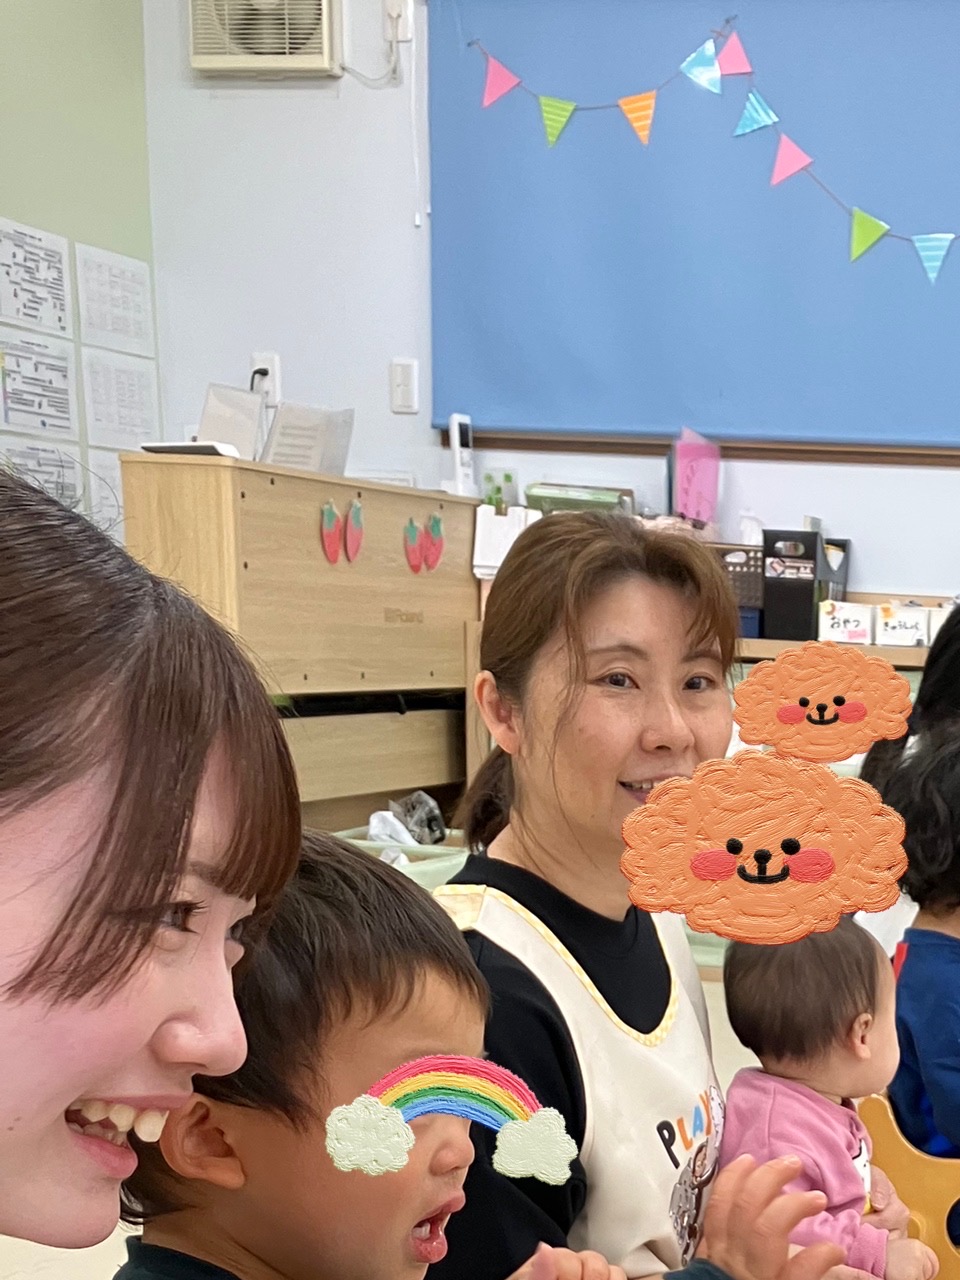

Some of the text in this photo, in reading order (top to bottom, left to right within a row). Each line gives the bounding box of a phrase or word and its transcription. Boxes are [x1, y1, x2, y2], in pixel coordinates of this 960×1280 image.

[830, 615, 860, 629] おやつ
[657, 1090, 712, 1169] PLAY
